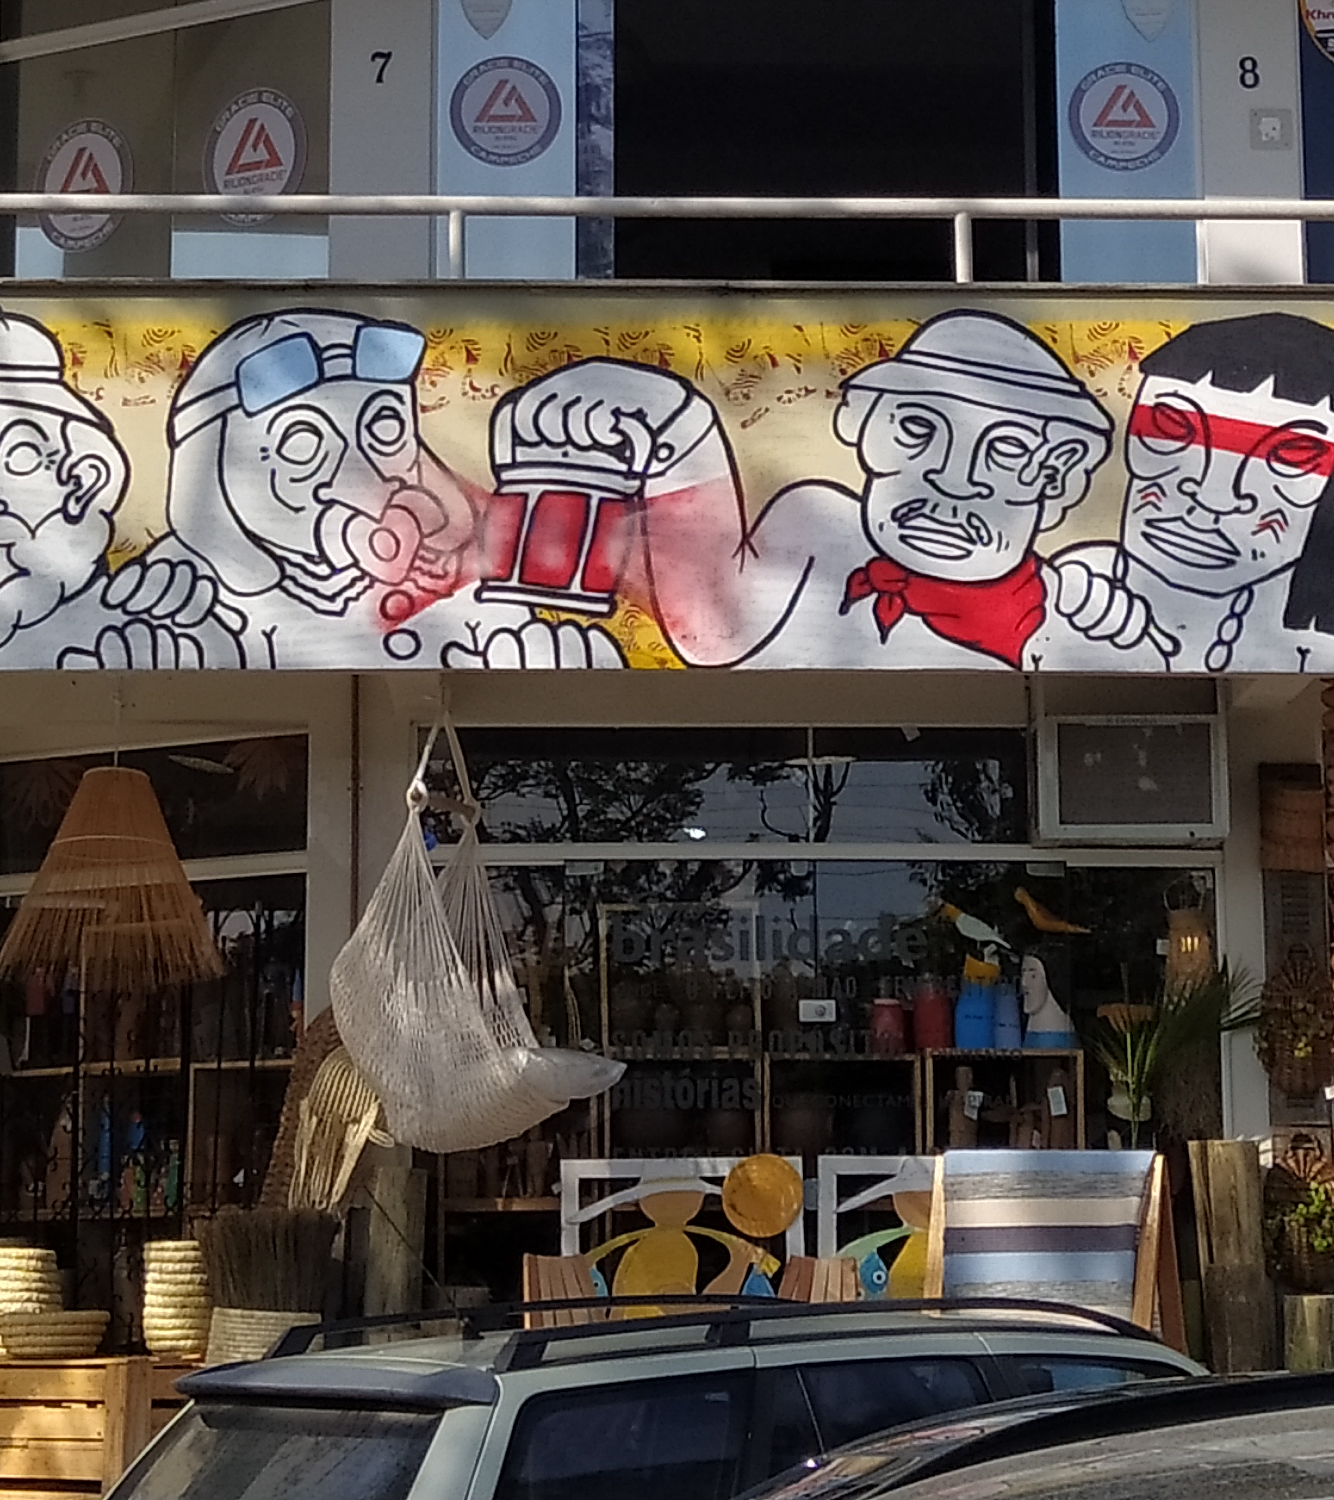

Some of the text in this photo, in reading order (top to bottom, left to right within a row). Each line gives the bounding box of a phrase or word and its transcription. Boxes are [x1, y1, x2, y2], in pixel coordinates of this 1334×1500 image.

[371, 51, 392, 84] 7
[1238, 56, 1260, 89] 8
[611, 911, 928, 963] brasilidade
[612, 1068, 762, 1110] histórias
